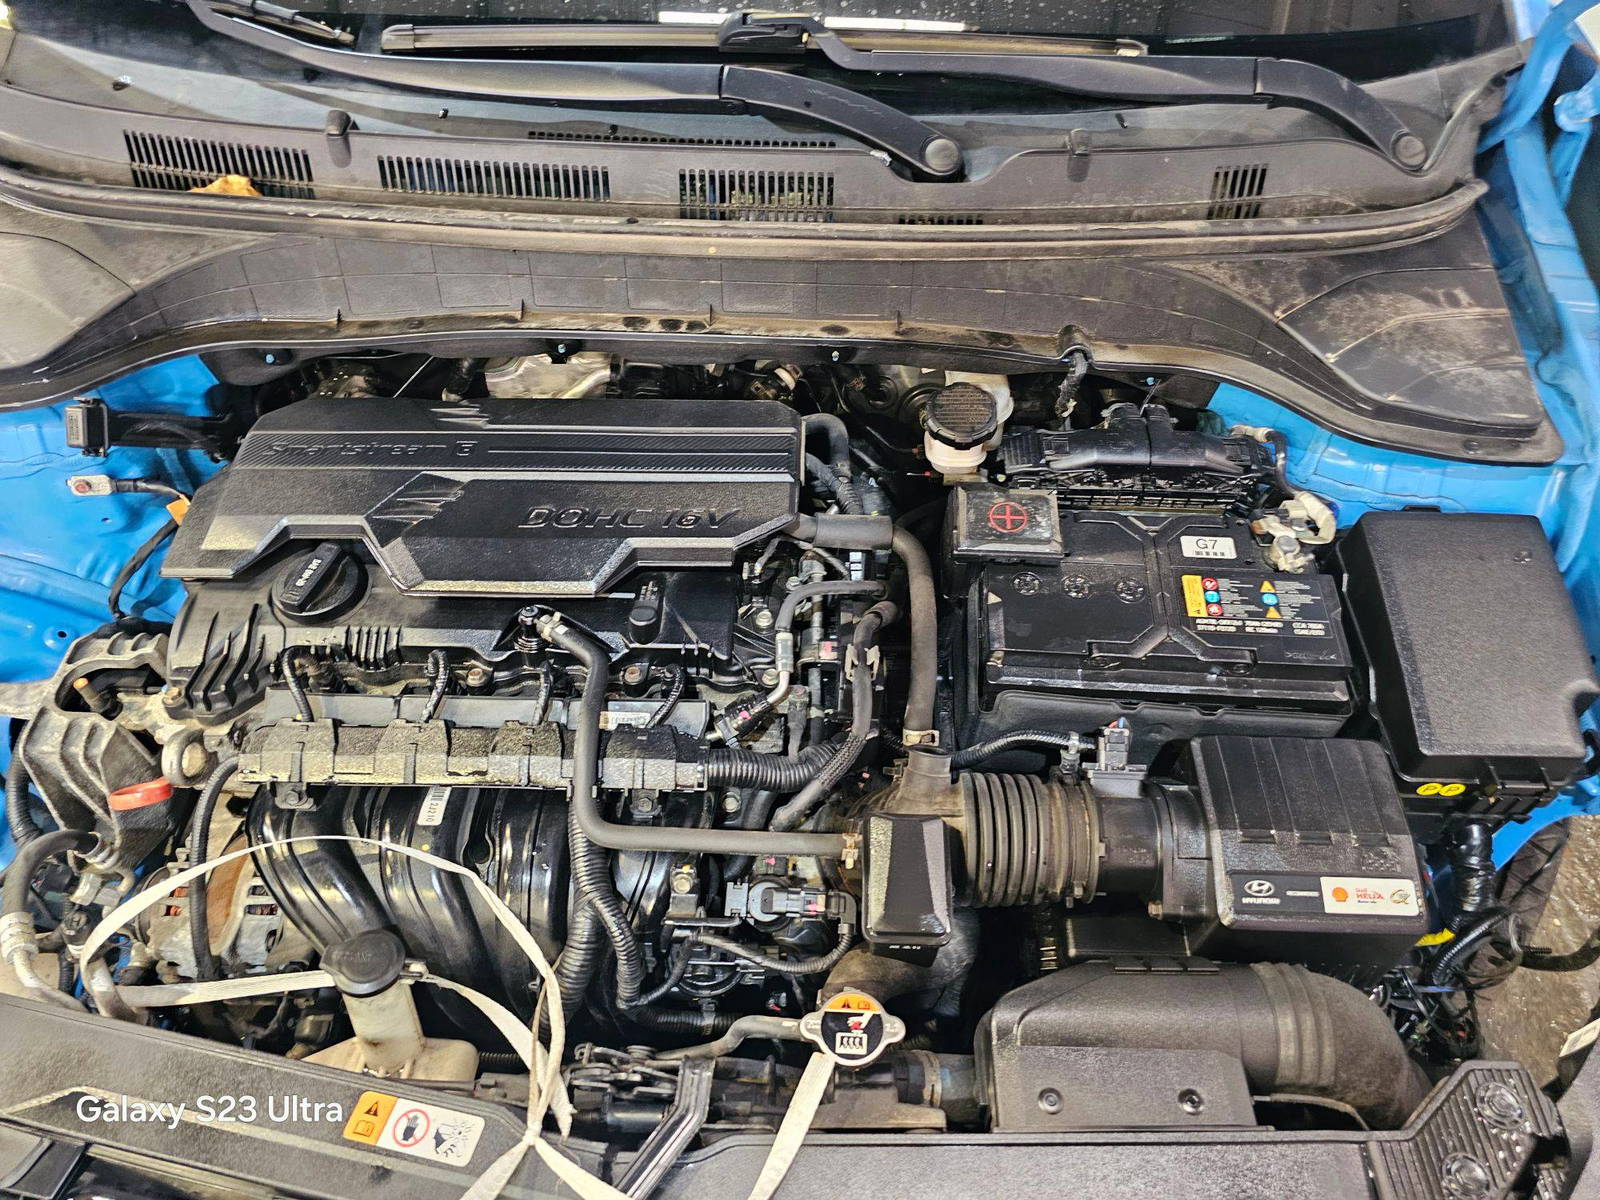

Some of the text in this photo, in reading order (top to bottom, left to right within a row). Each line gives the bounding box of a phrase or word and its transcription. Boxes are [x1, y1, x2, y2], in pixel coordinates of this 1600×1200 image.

[517, 506, 743, 529] DOHC 16V
[1195, 538, 1218, 550] G7
